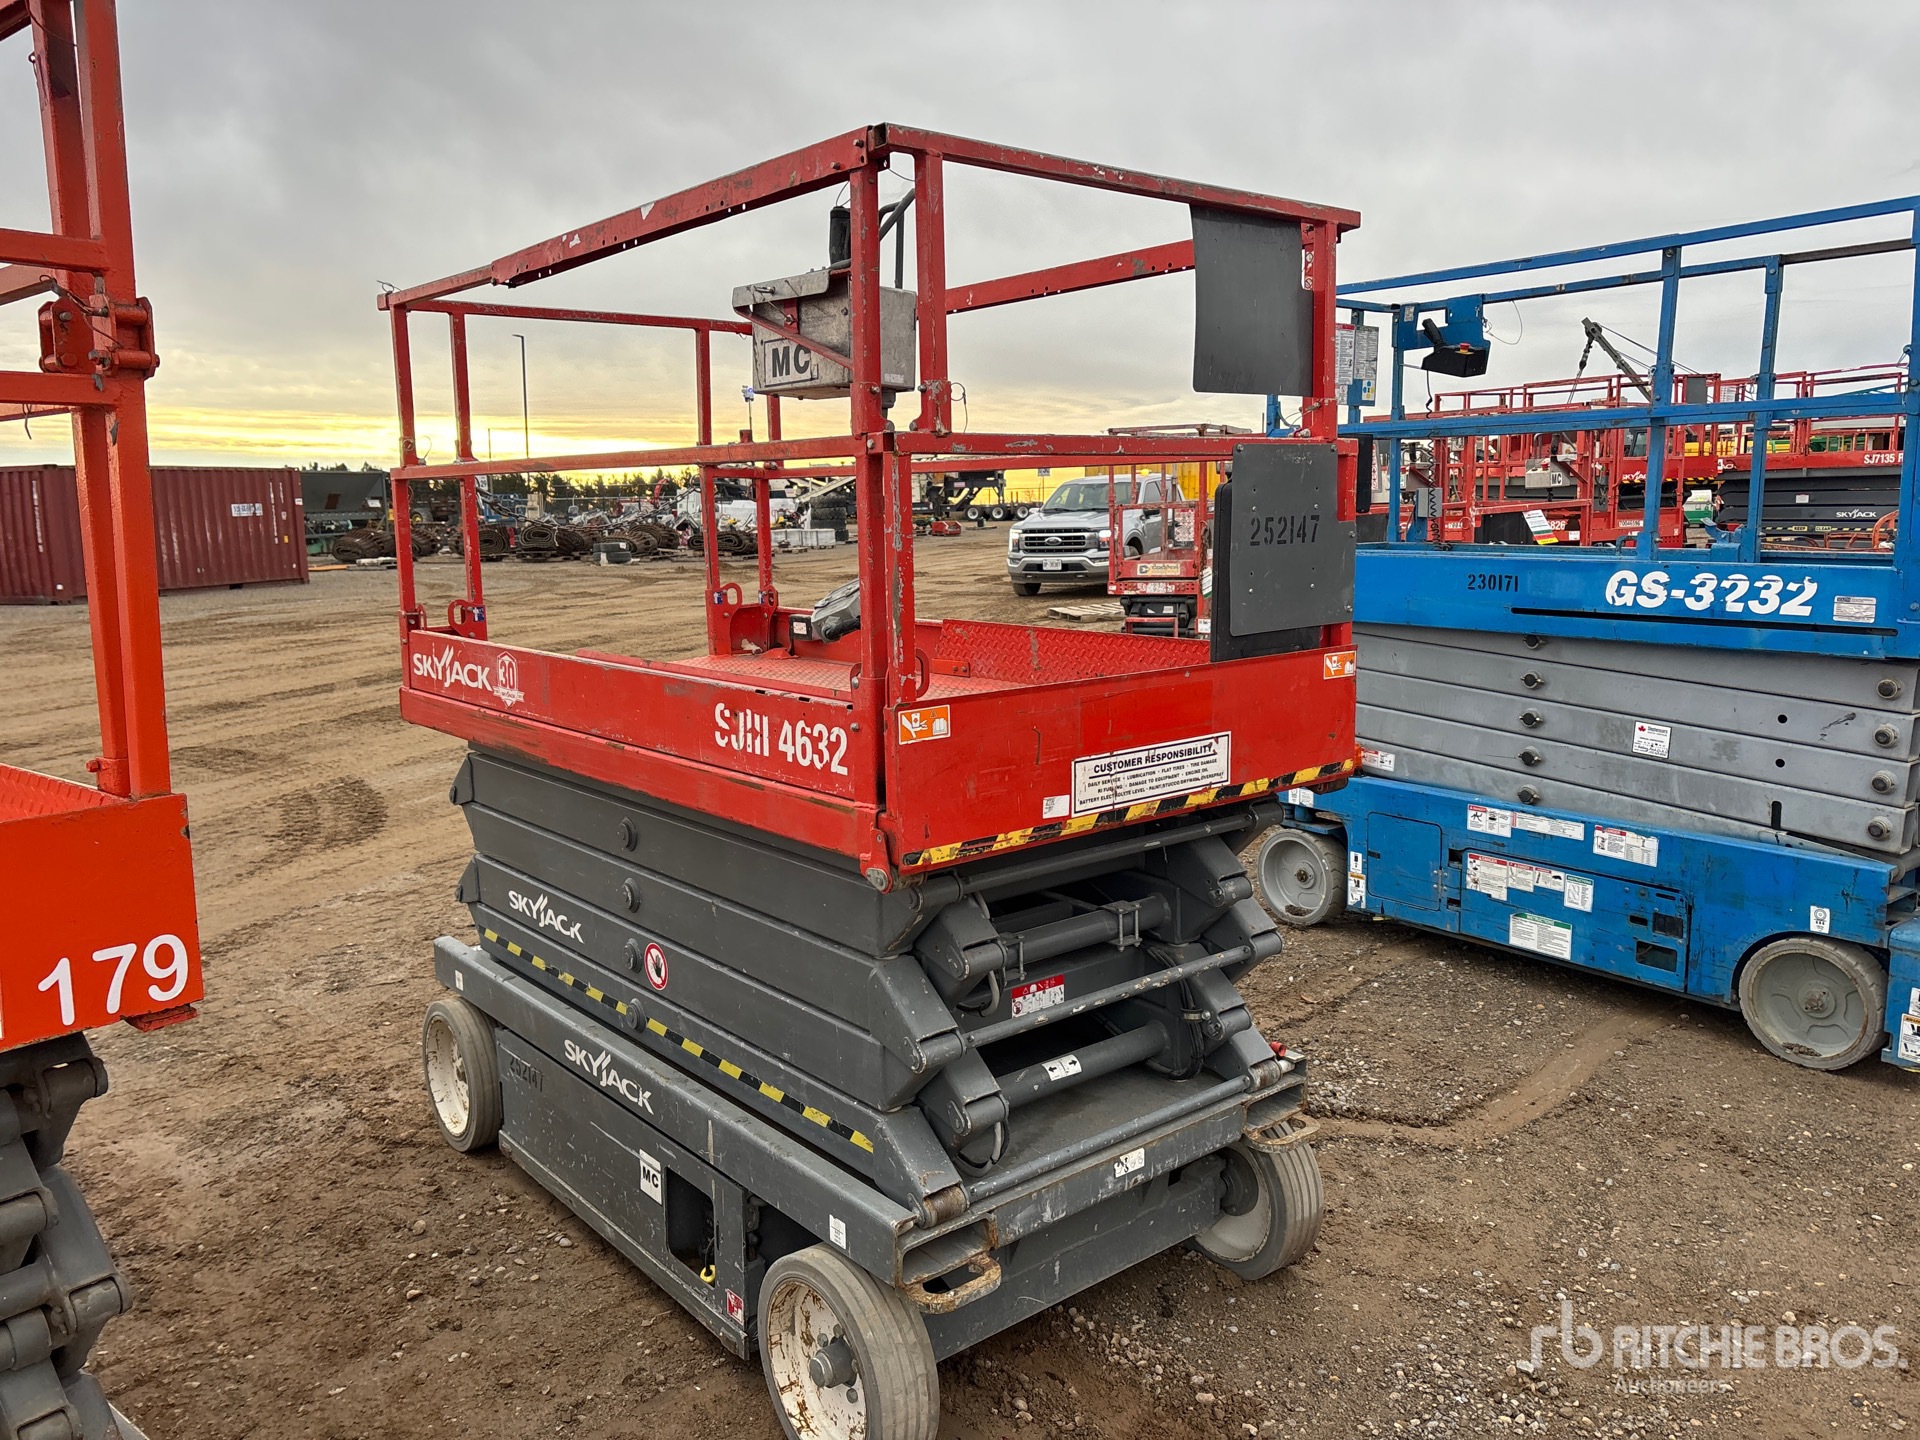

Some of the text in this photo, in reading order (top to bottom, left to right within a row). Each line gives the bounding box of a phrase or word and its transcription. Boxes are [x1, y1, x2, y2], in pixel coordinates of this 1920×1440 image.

[771, 344, 811, 378] MC
[1863, 453, 1896, 464] SJ7135
[1551, 472, 1563, 485] MC
[1547, 520, 1566, 530] 826
[1835, 508, 1877, 519] SKYJACK
[1249, 514, 1320, 546] 252147
[1467, 573, 1519, 592] 230171
[1605, 570, 1818, 616] GS-3232
[412, 644, 493, 692] SKYJACK
[500, 659, 517, 690] 30
[778, 719, 848, 776] 4632
[1093, 742, 1213, 774] CUSTOMER RESPONSIBILITY
[1126, 771, 1156, 780] LUBRICATION
[1200, 758, 1218, 766] DAMAGE
[1128, 779, 1147, 788] DAMAGE
[1154, 773, 1180, 783] EQUIPMENT
[1185, 769, 1201, 777] ENGINE
[1079, 796, 1100, 805] BATTERY
[1100, 790, 1132, 801] ELECTOLYTE
[508, 890, 585, 944] SKYJACK
[37, 933, 189, 1026] 179
[563, 1039, 655, 1116] SKYJACK
[642, 1165, 659, 1189] MC
